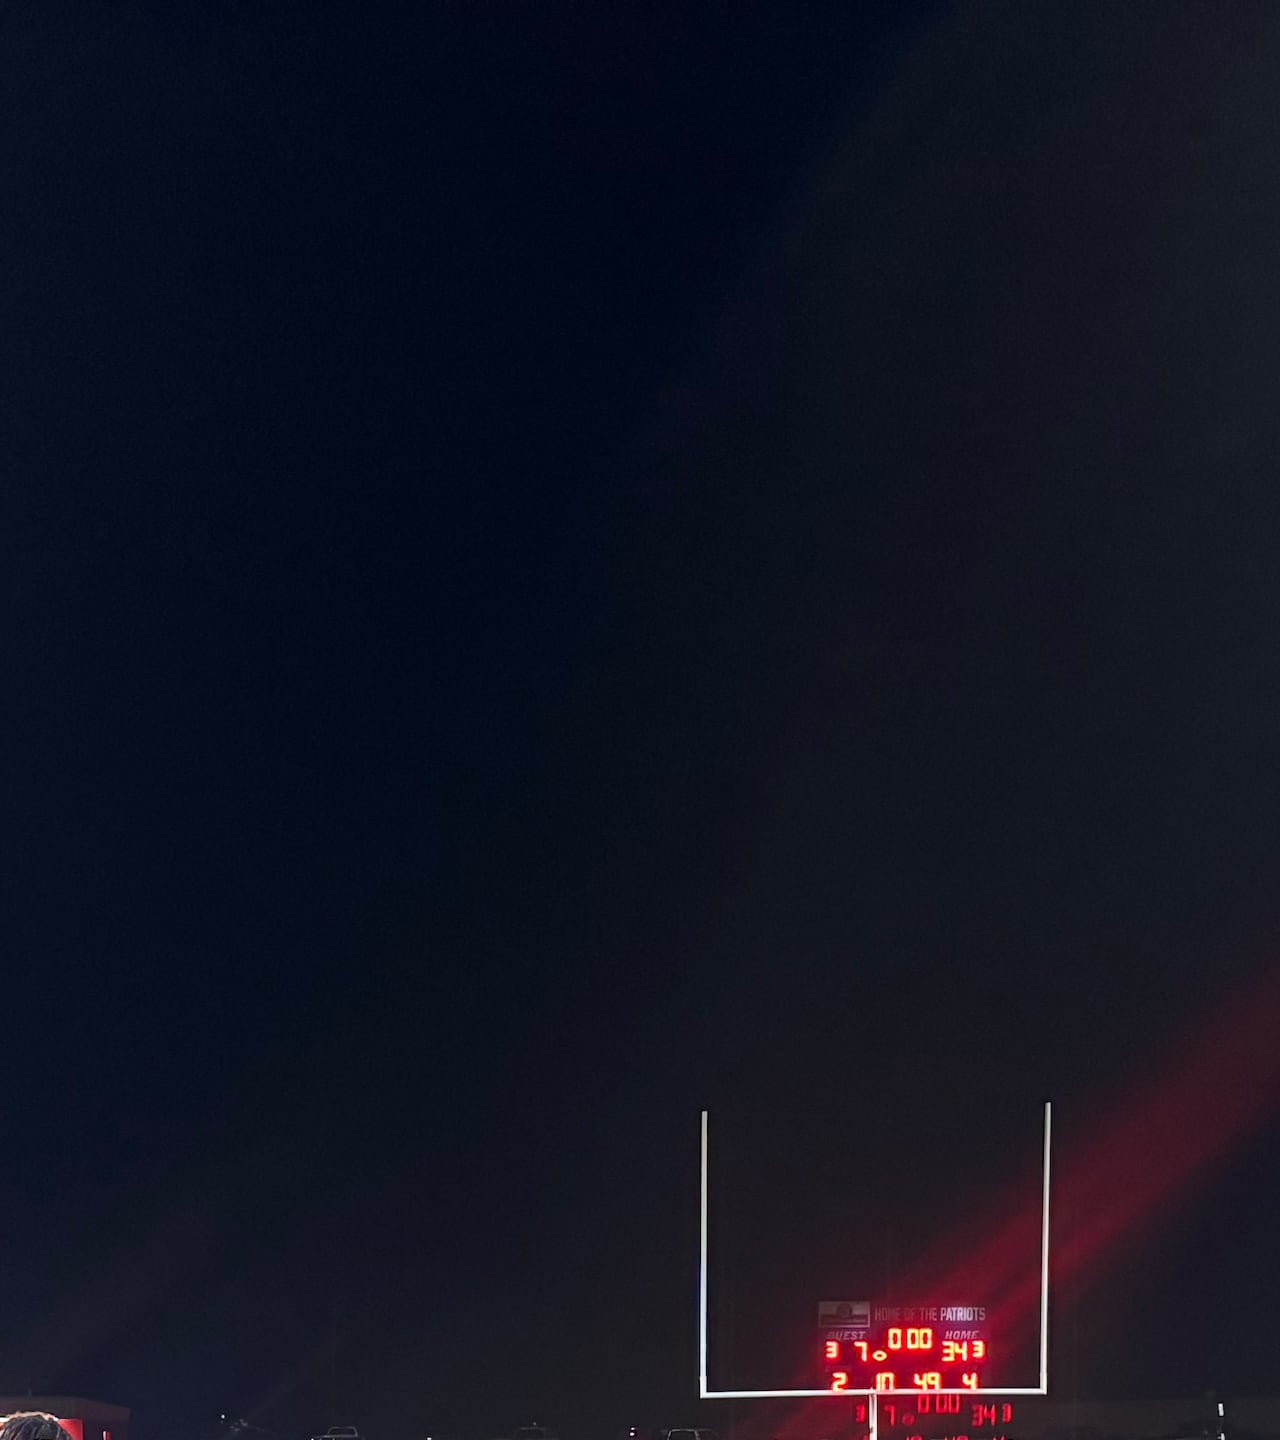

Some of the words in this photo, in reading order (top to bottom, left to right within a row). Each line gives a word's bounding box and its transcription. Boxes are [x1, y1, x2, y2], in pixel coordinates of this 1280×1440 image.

[874, 1307, 900, 1321] HOME
[920, 1307, 937, 1321] THE
[940, 1306, 986, 1321] PATRIOTS
[827, 1330, 866, 1340] GUEST
[944, 1330, 980, 1340] HOME
[826, 1341, 839, 1358] 3
[854, 1341, 868, 1362] 7
